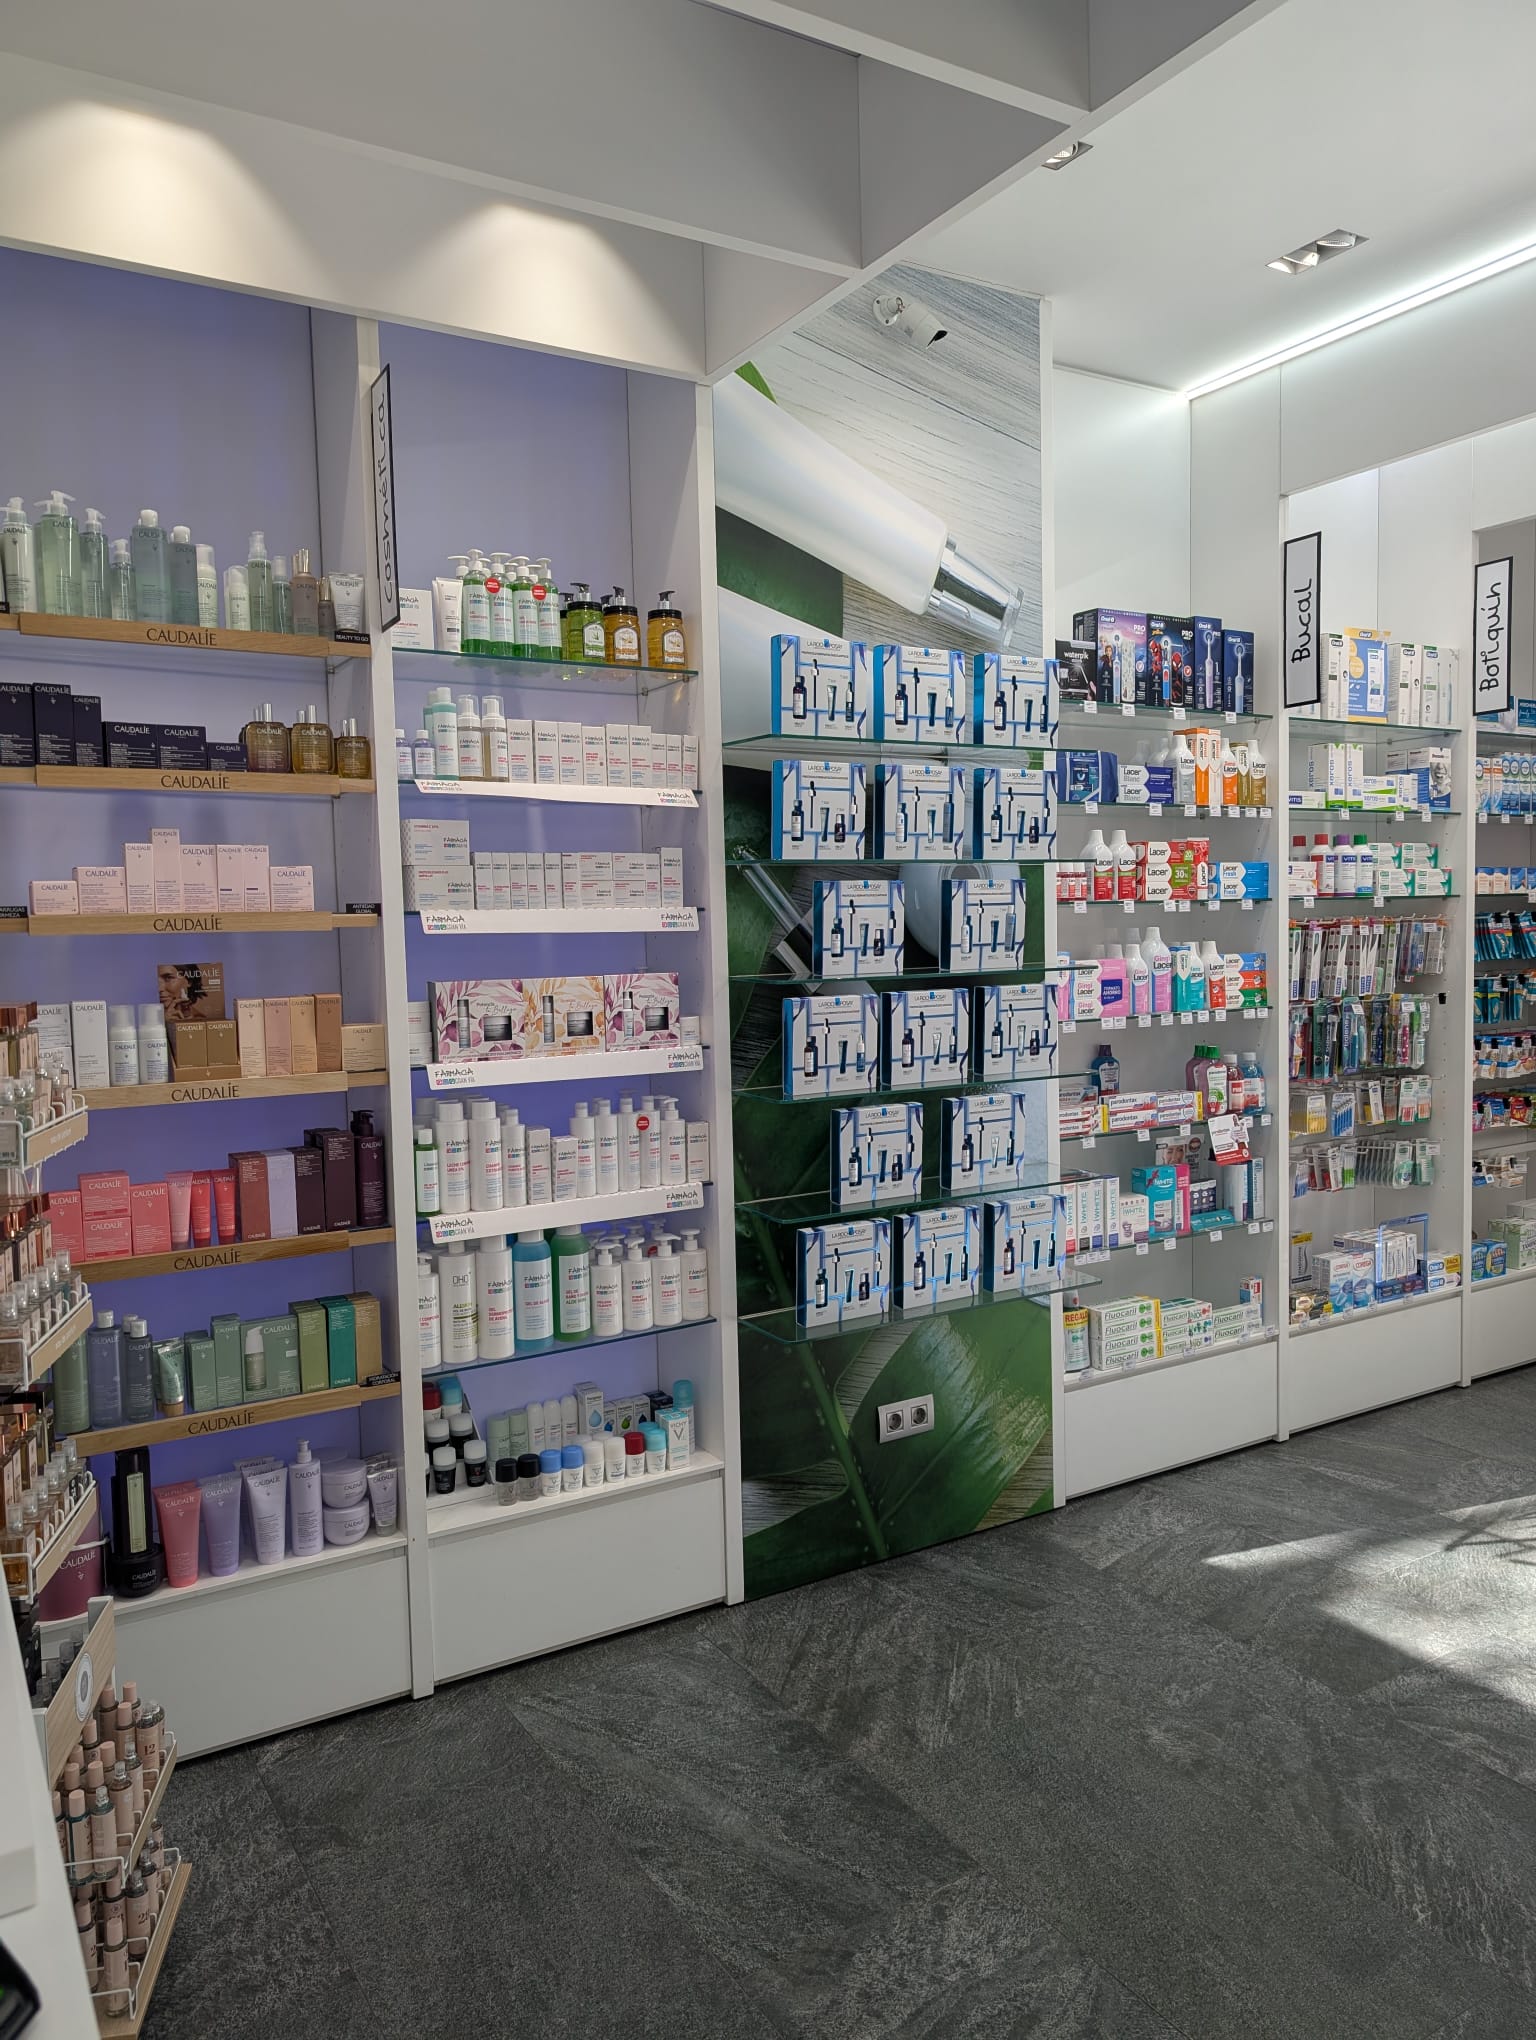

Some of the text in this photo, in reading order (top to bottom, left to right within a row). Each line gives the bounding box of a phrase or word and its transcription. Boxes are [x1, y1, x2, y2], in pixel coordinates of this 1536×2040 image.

[1291, 578, 1312, 664] Bucal
[1181, 630, 1193, 638] PRO
[1478, 581, 1504, 693] Botiquín
[1063, 650, 1089, 660] waterpik
[1123, 767, 1142, 776] Lacer
[1123, 787, 1142, 795] Lacer
[1149, 847, 1168, 856] Lacer
[1147, 868, 1168, 876] Lacer
[1147, 886, 1168, 895] Lacer
[1154, 955, 1171, 963] Gingi
[1153, 961, 1172, 969] Lacer
[1110, 1097, 1137, 1106] parodontax
[1111, 1115, 1138, 1123] parodontax
[1104, 1307, 1137, 1321] Fluocaril
[1214, 1311, 1244, 1324] Fluocaril
[1105, 1322, 1137, 1336] Fluocaril
[1214, 1325, 1244, 1339] Fluocaril
[1105, 1336, 1138, 1350] Fluocaril
[1105, 1351, 1139, 1365] Fluocaril
